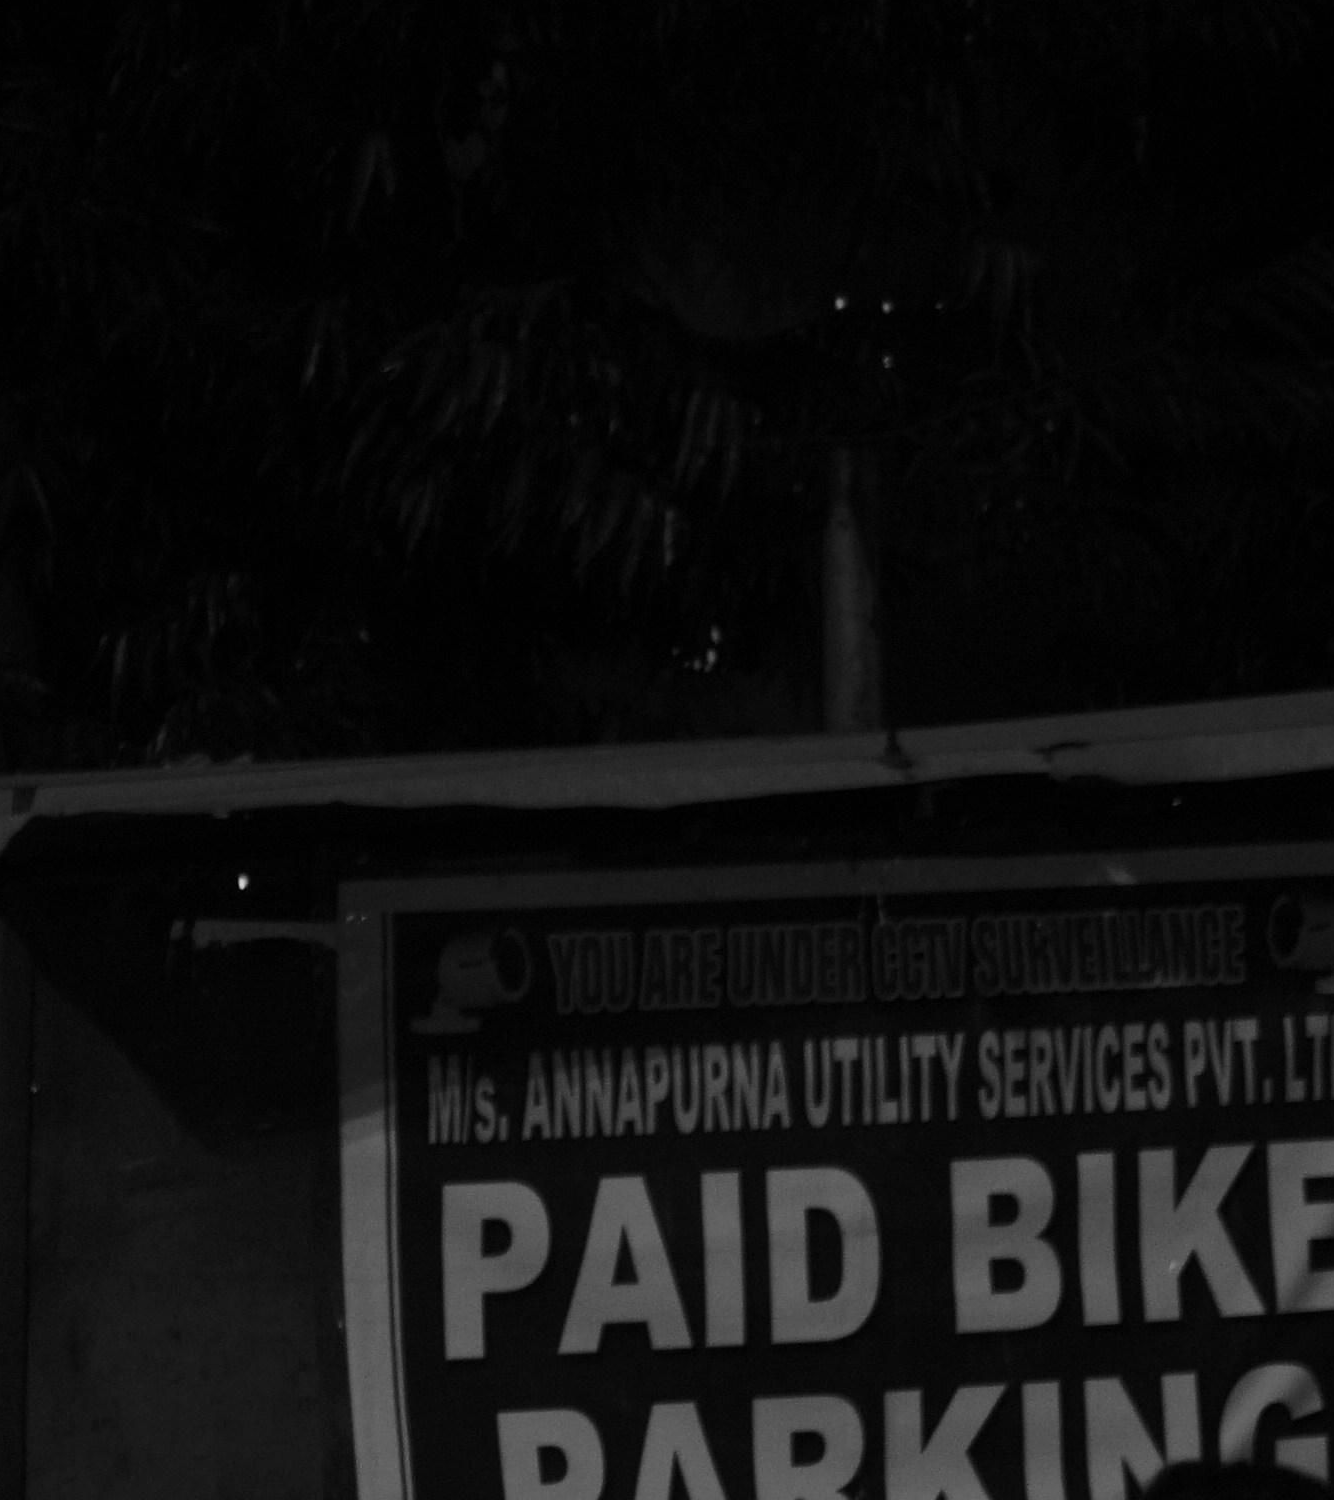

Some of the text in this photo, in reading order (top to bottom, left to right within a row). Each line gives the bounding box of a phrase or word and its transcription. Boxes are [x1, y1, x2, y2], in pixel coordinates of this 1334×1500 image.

[545, 904, 1248, 1015] YOU ARE UNDER CCTV SURVEILLANCE
[521, 1040, 793, 1143] ANNAPURNA
[803, 1031, 966, 1130] UTILITY
[977, 1018, 1174, 1121] SERVICES
[1183, 1014, 1274, 1109] PVT.
[441, 1165, 883, 1364] PAID
